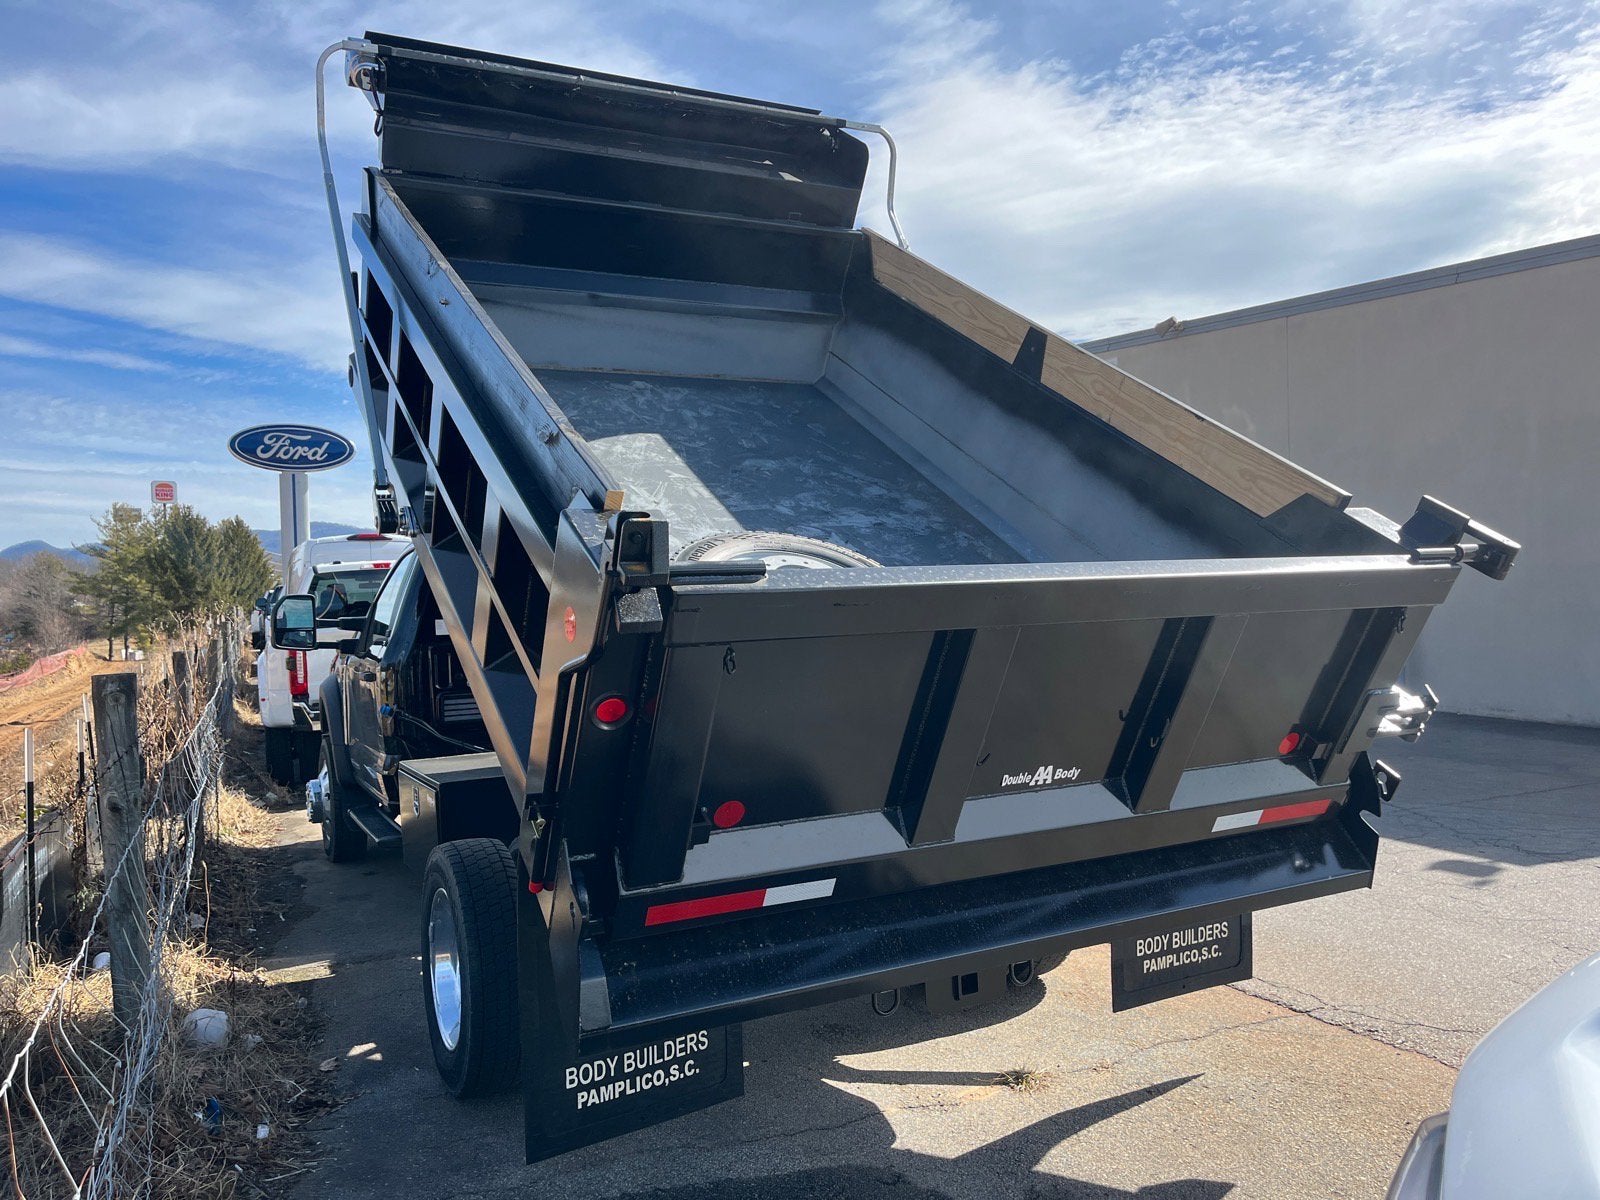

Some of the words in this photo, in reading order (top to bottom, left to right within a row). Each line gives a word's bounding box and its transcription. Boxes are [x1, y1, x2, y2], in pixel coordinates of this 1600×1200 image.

[256, 432, 330, 461] Ford
[688, 541, 718, 561] nental
[1001, 771, 1032, 787] Double
[1029, 765, 1053, 786] AA
[1053, 766, 1082, 780] Body
[1136, 934, 1169, 957] BODY
[1172, 921, 1228, 949] BUILDERS
[565, 1056, 618, 1089] BODY
[623, 1030, 709, 1073] BUILDERS
